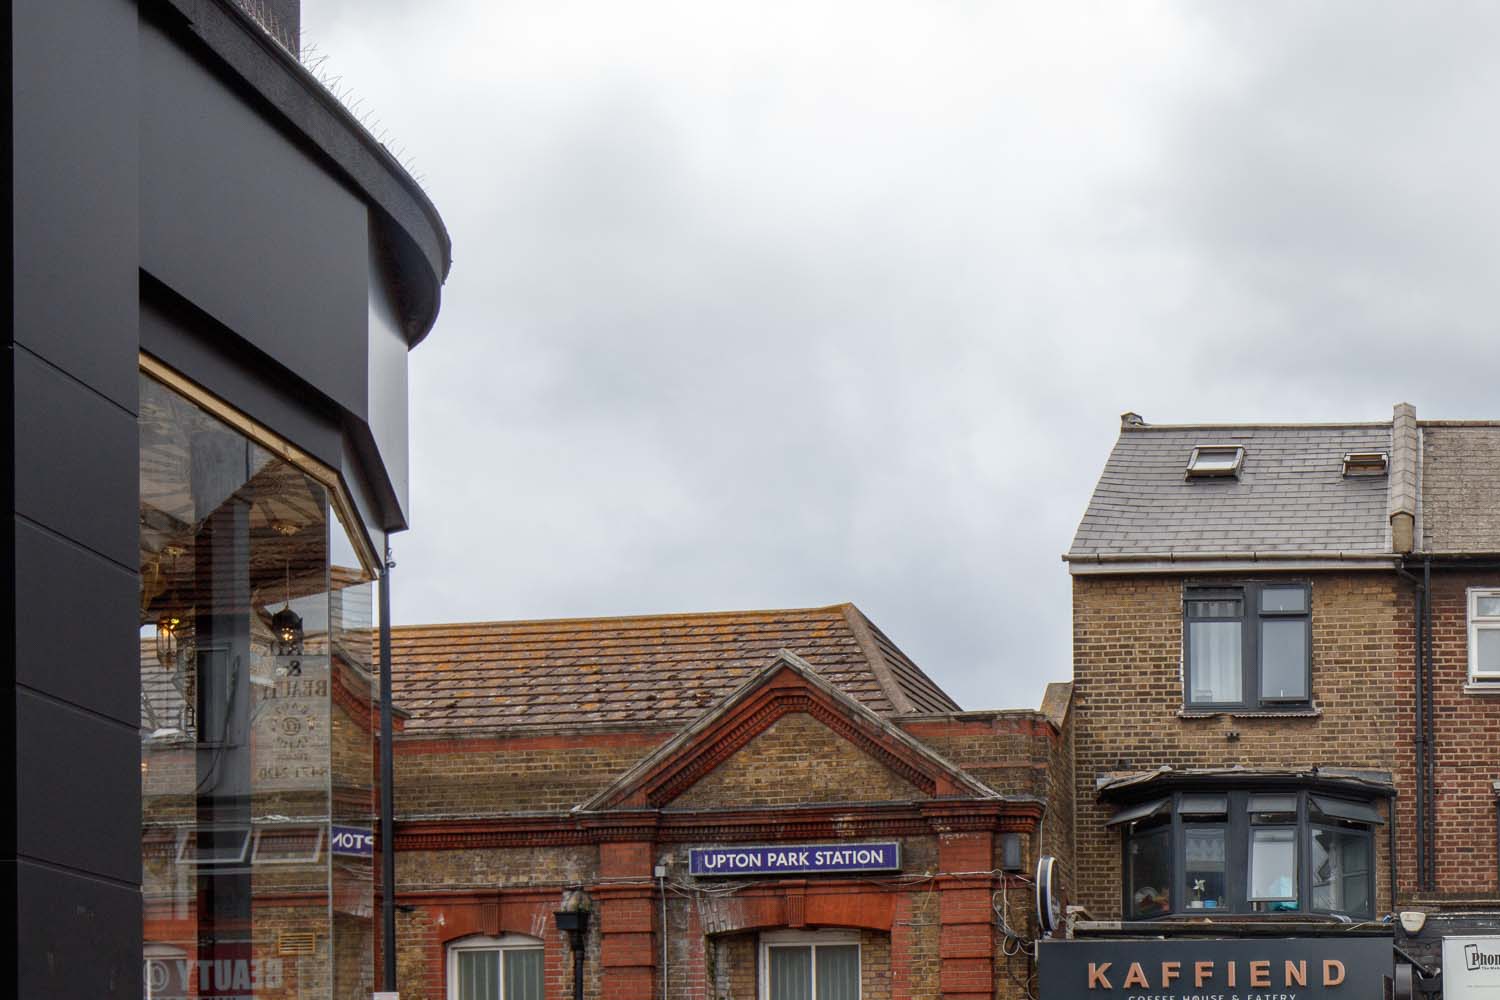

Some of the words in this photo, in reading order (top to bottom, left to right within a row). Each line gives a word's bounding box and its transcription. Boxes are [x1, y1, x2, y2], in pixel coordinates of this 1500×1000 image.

[704, 853, 762, 869] UPTON
[768, 852, 809, 867] PARK
[815, 850, 883, 865] STATION
[1088, 959, 1346, 989] KAFFIEND
